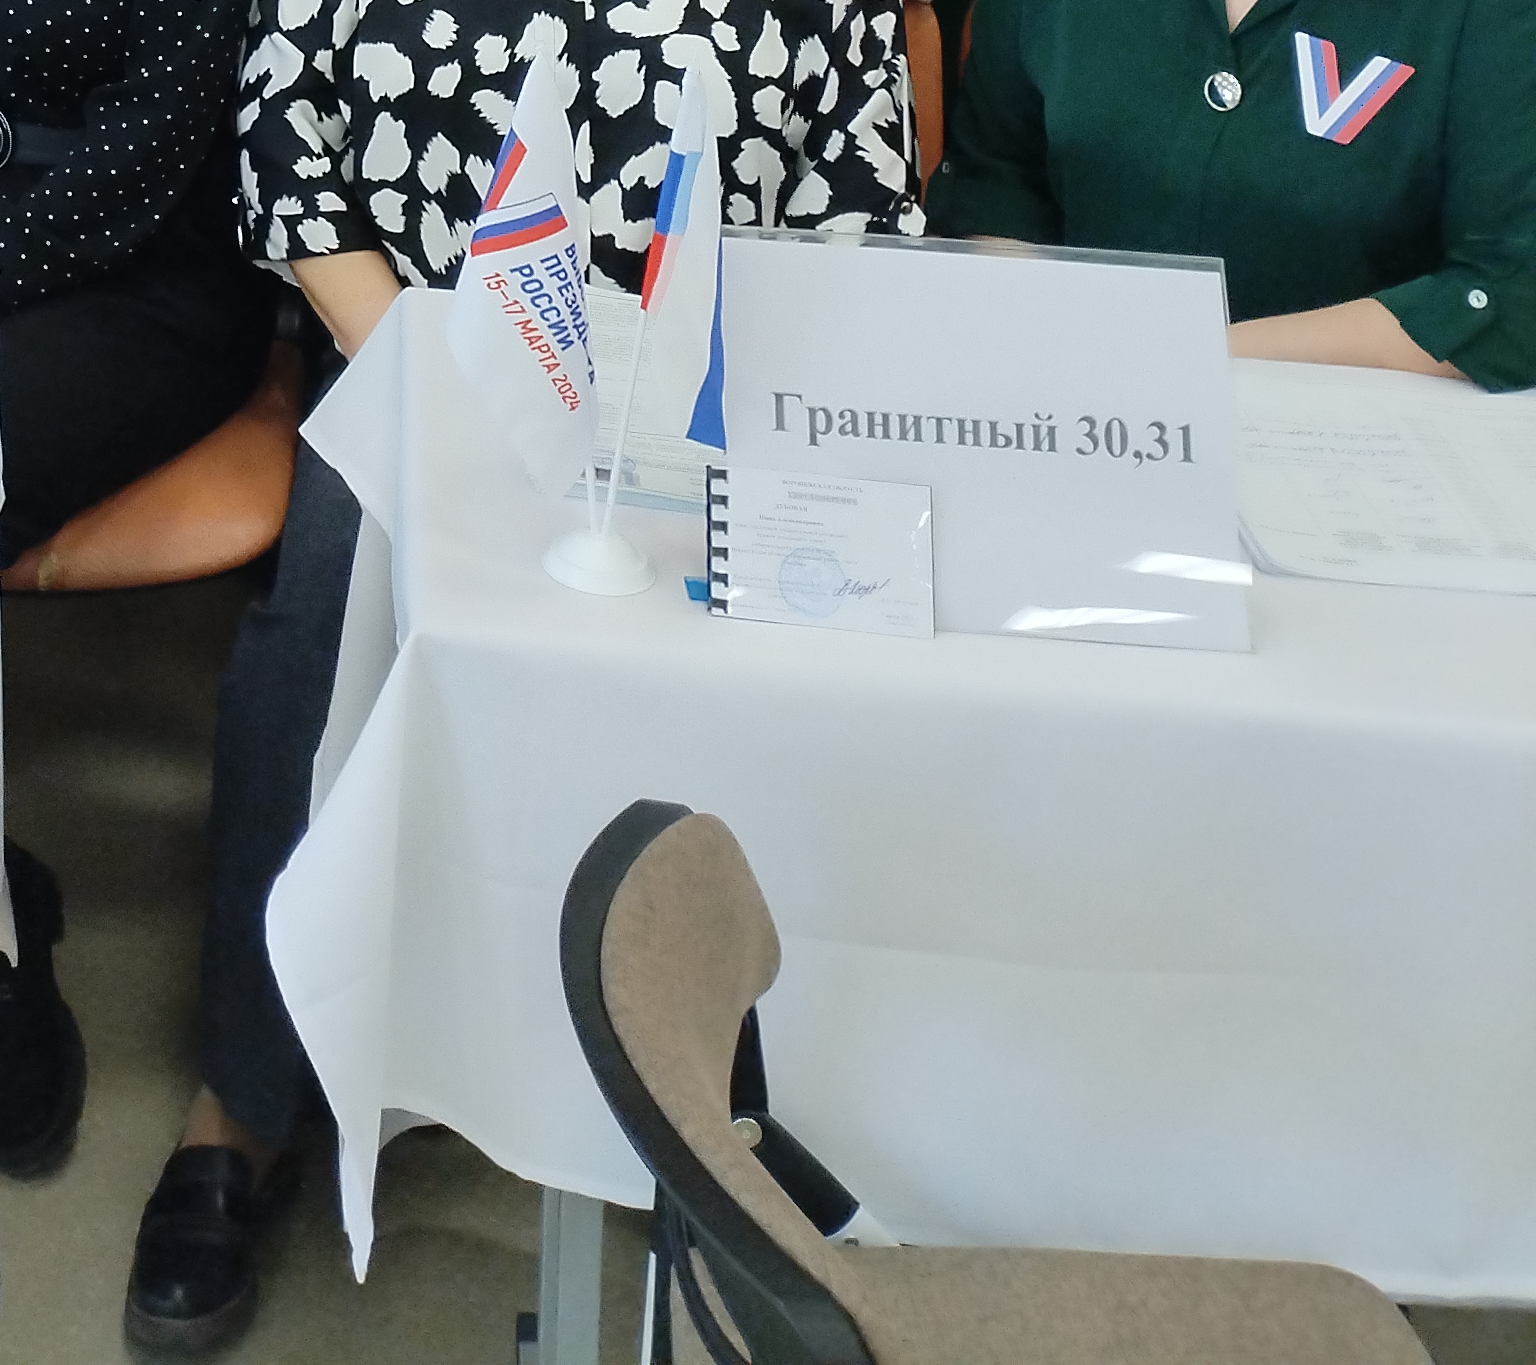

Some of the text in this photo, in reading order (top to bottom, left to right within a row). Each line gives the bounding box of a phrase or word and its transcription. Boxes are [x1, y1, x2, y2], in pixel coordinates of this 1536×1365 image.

[509, 262, 575, 352] РОССИИ
[513, 318, 562, 375] МАРТА
[551, 373, 581, 412] 2024
[771, 392, 1059, 452] Гранитный
[1075, 415, 1195, 468] 30,31
